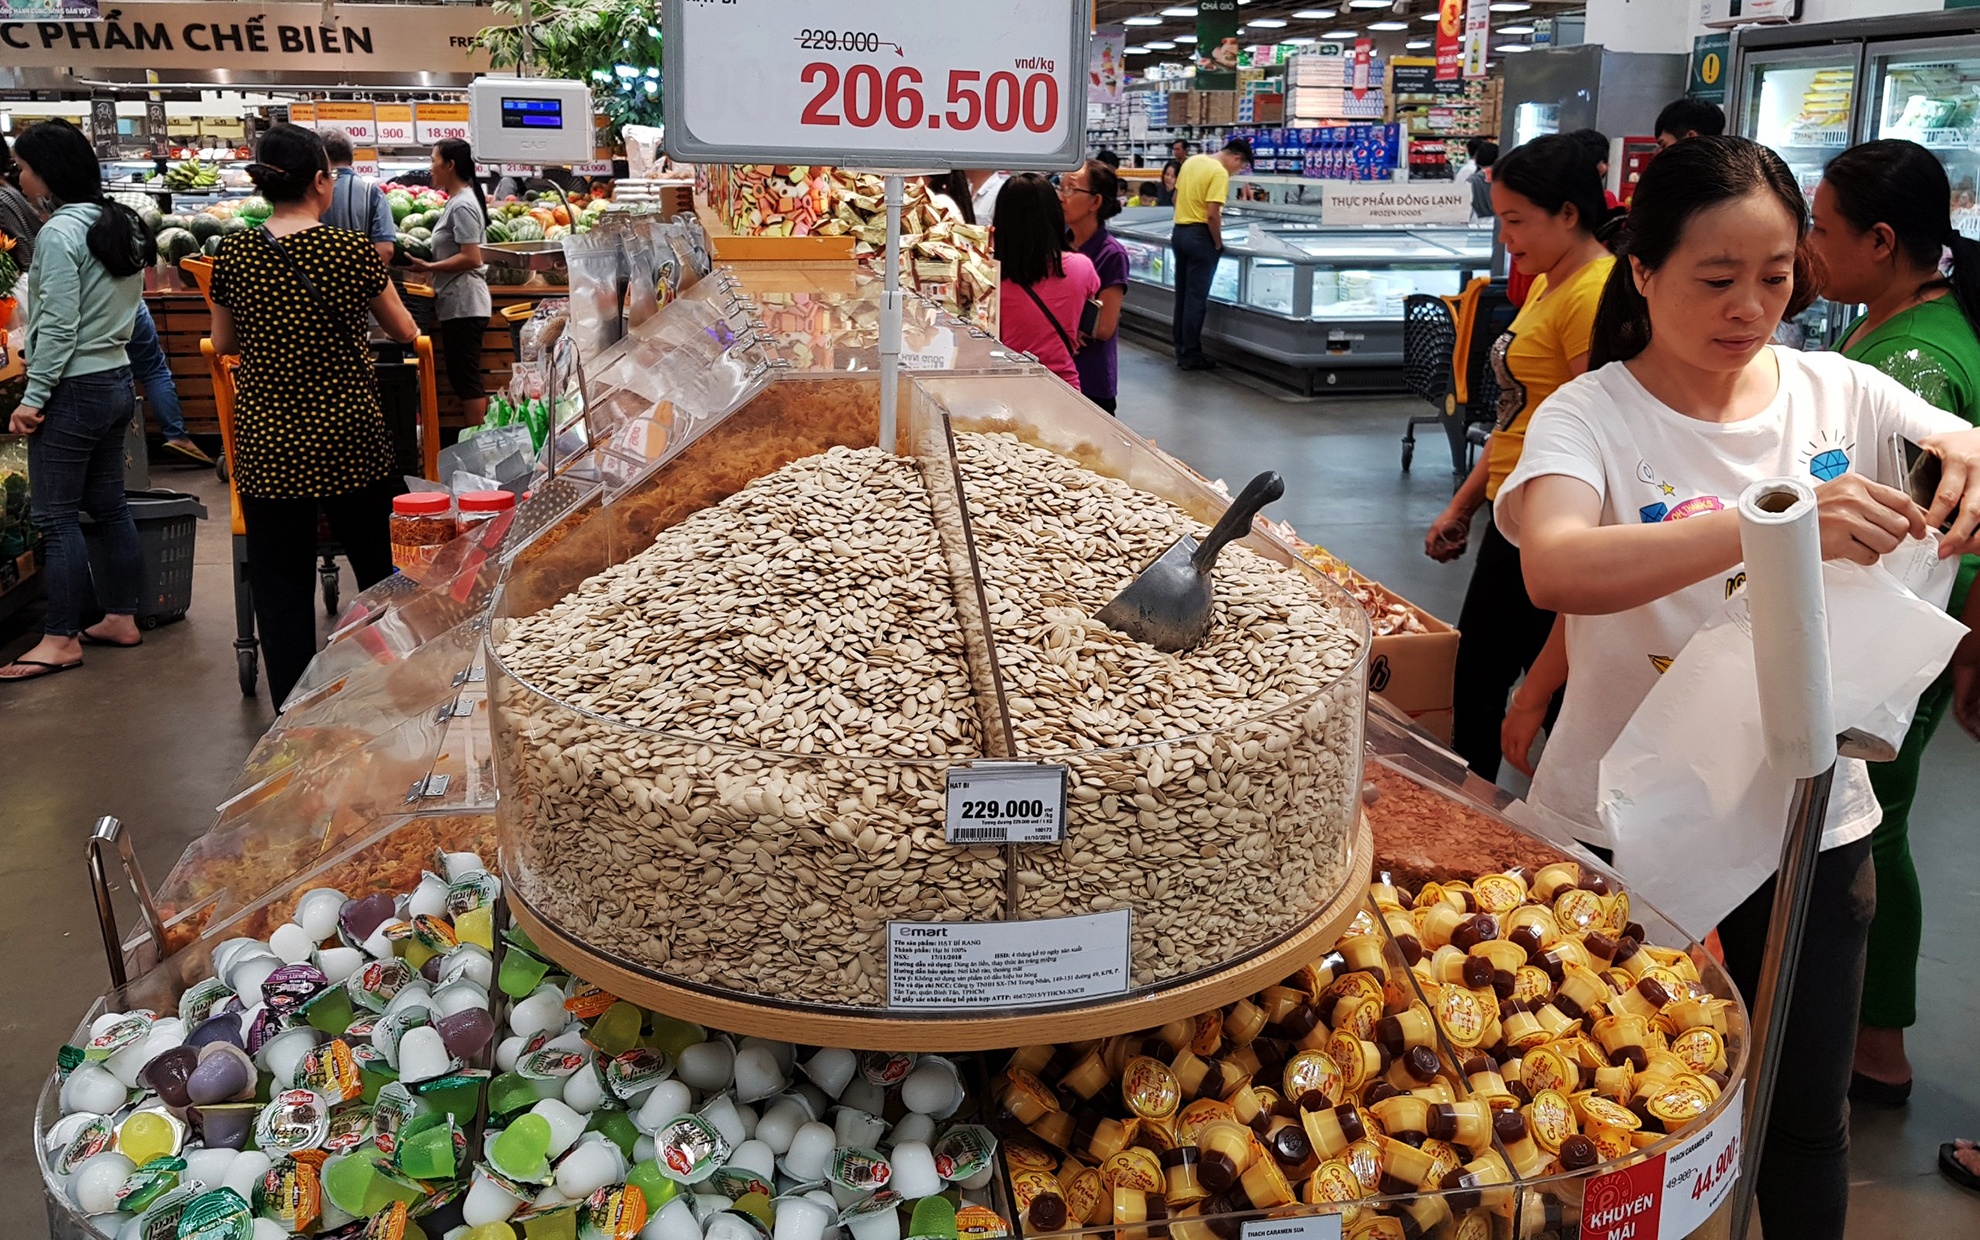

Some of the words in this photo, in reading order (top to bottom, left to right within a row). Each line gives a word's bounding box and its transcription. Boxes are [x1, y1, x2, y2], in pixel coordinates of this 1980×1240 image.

[36, 10, 171, 51] PHẨM
[182, 14, 268, 52] CHẾ
[280, 15, 375, 55] BIẾN
[801, 28, 878, 52] 229.000
[1014, 56, 1055, 74] vnd/kg
[800, 62, 1058, 134] 206.500
[427, 128, 465, 138] 18.900
[1331, 196, 1360, 208] THỰC
[1362, 192, 1394, 206] PHẨM
[1396, 194, 1429, 206] ĐÔNG
[1431, 195, 1462, 208] LẠNH
[1398, 209, 1422, 217] FOODS
[962, 800, 1043, 818] 229.000
[900, 926, 948, 937] emart
[1691, 1136, 1736, 1201] 44.900
[1590, 1192, 1654, 1229] KHUYẾN
[1608, 1222, 1636, 1240] MÃI
